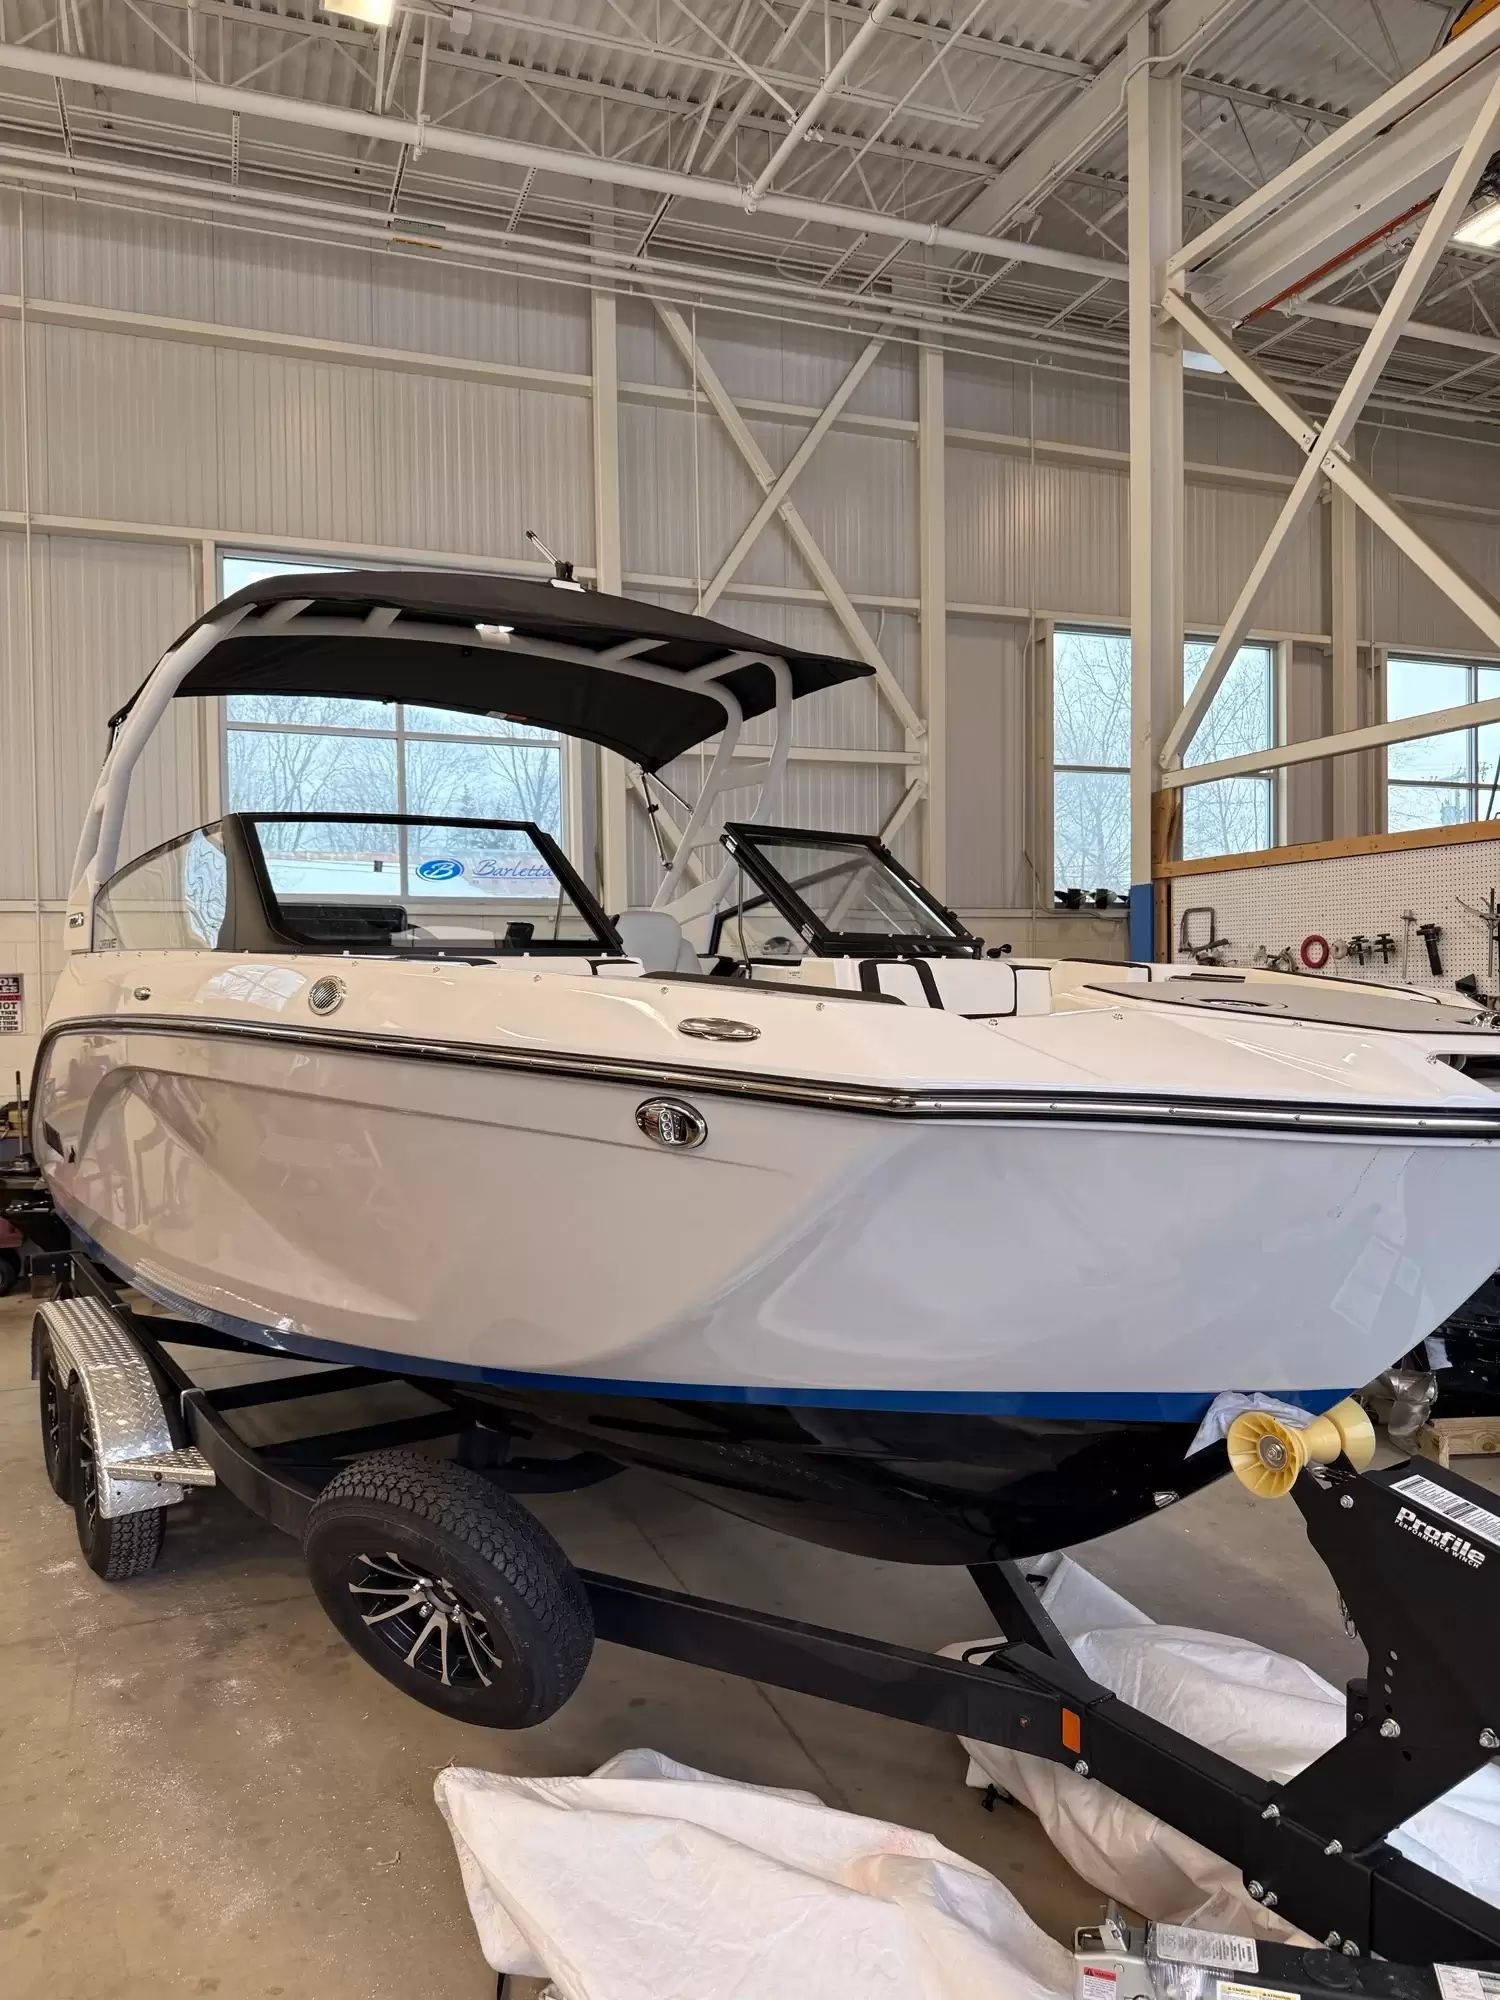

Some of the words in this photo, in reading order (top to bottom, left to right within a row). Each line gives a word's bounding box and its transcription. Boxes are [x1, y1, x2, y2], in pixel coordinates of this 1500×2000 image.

[472, 859, 553, 877] Barletta
[1394, 1519, 1450, 1553] PERFORMANCE
[1452, 1552, 1480, 1569] WINCH
[1396, 1507, 1486, 1566] Profile
